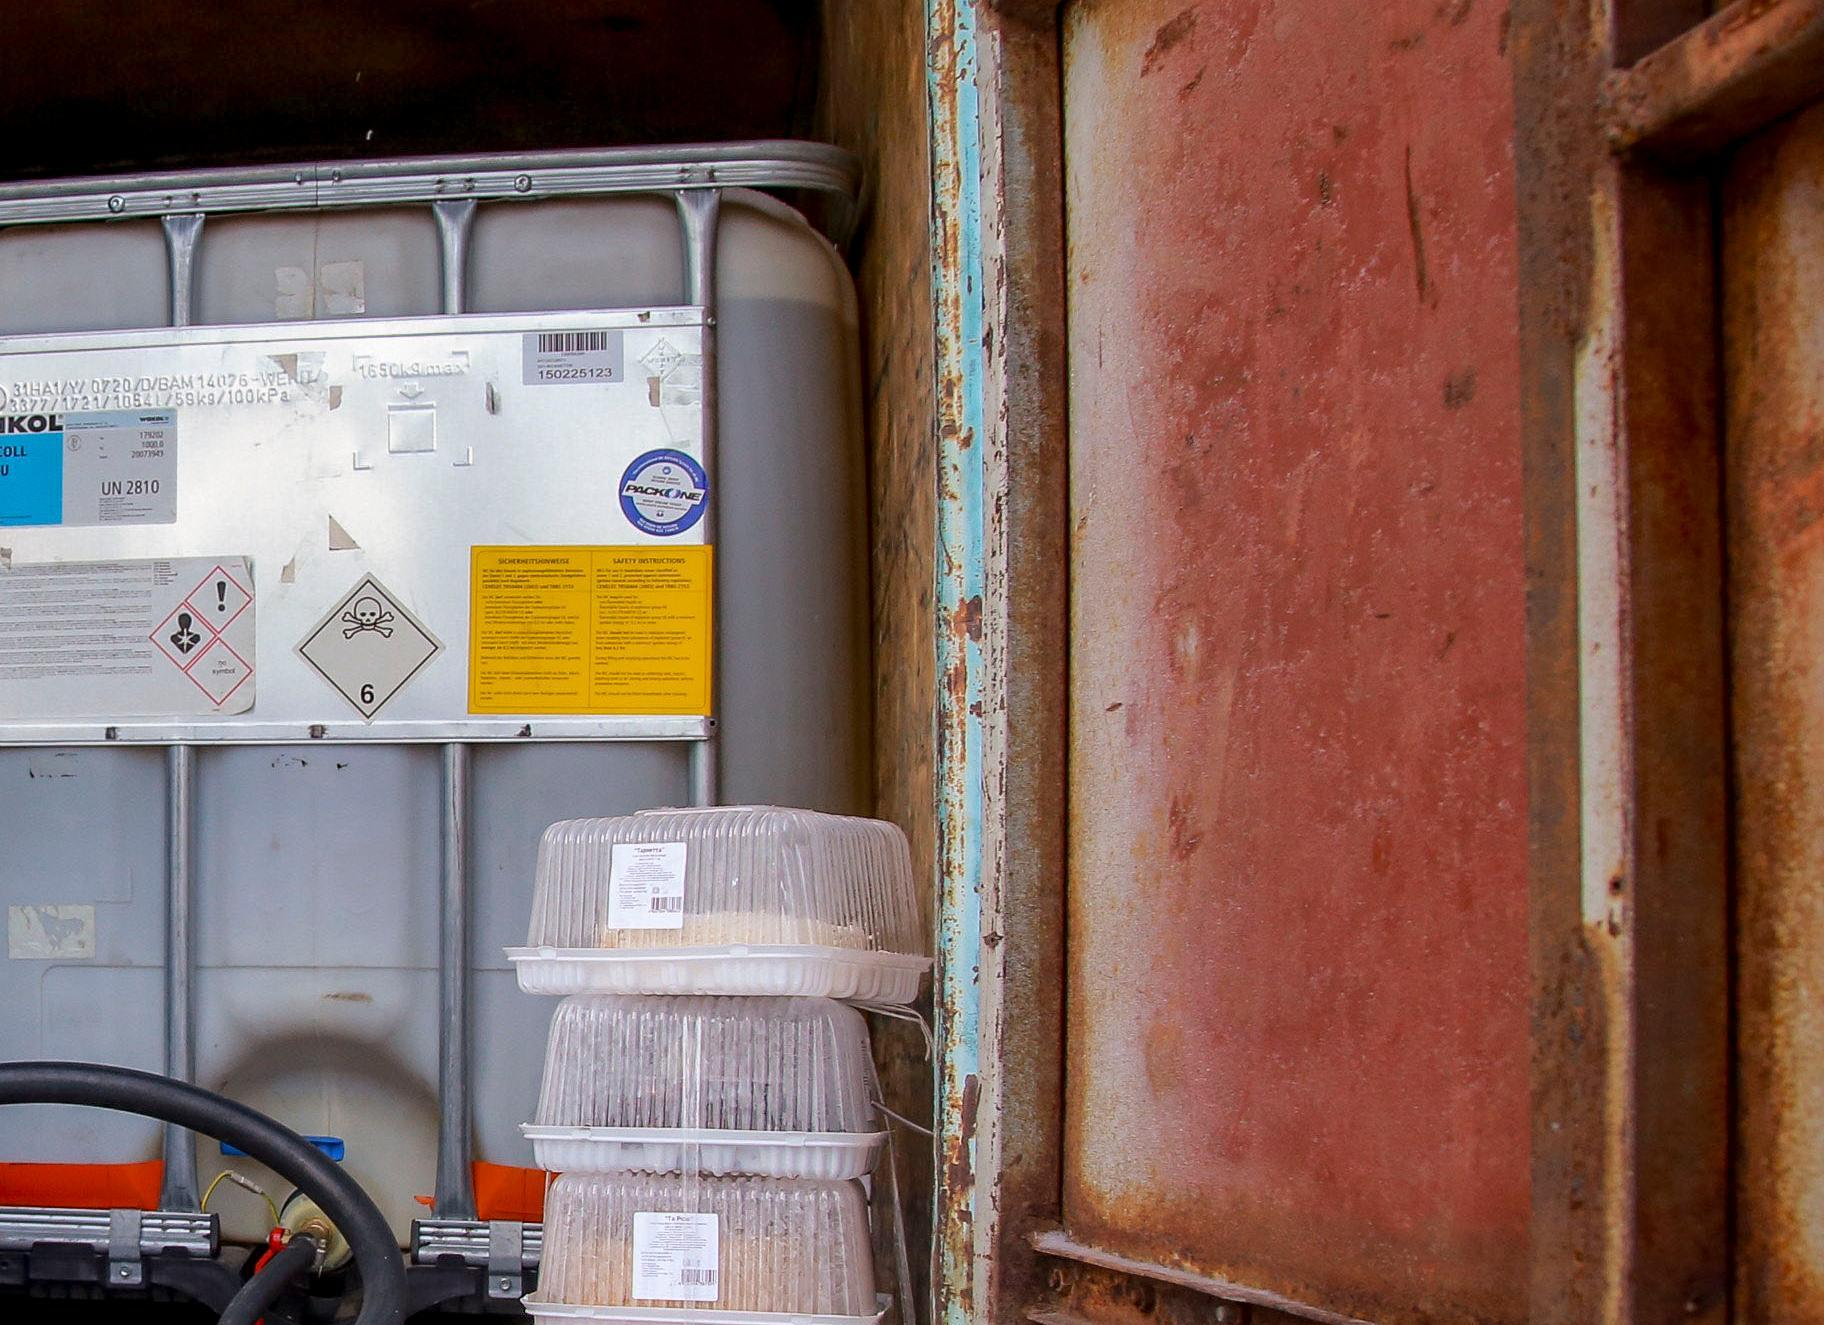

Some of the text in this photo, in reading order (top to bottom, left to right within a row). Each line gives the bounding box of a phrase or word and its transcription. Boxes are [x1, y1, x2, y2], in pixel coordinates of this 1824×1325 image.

[538, 368, 612, 379] 150225123
[1, 464, 9, 477] U
[102, 480, 160, 495] UN 2810
[625, 484, 702, 502] PACKONE
[360, 684, 375, 704] 6
